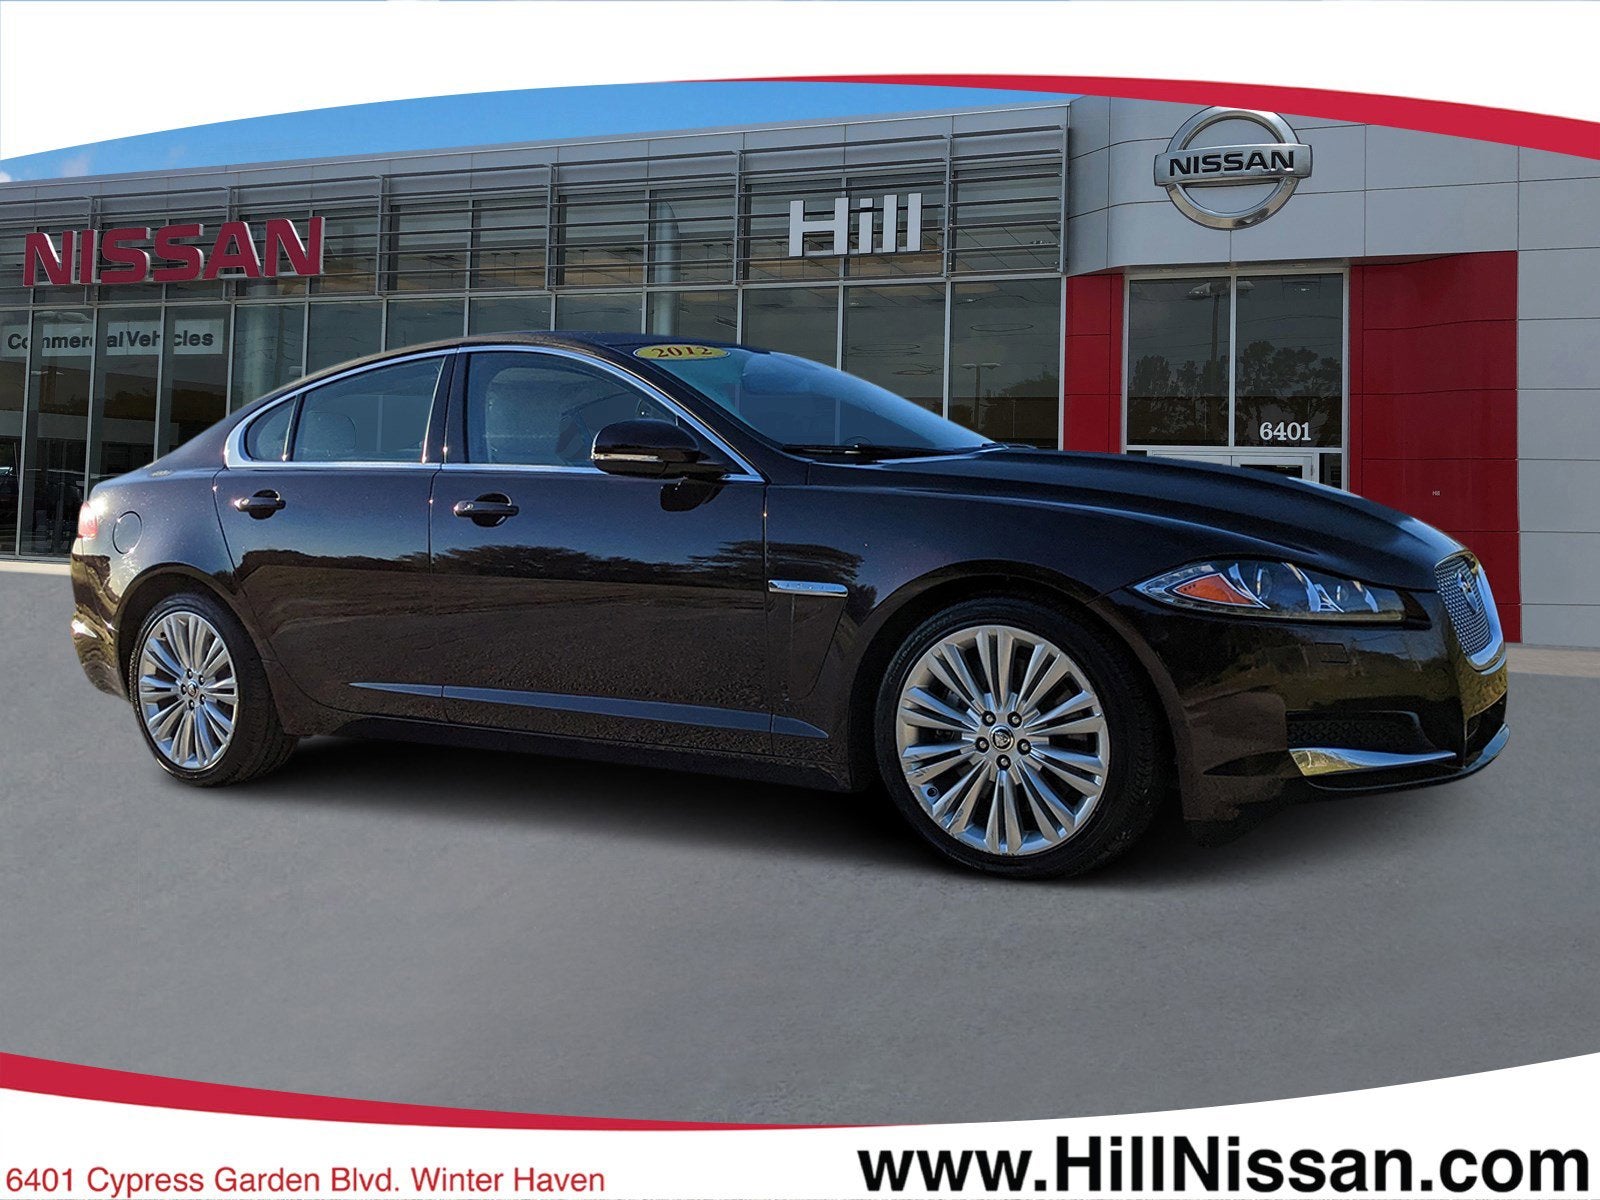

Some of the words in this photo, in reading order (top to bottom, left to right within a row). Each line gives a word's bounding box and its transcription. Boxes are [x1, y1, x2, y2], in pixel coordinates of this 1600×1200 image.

[1170, 150, 1294, 176] NISSAN
[788, 192, 923, 257] Hill
[23, 217, 325, 287] NISSAN
[8, 331, 123, 350] Comeral
[126, 330, 214, 347] Vehcles
[651, 346, 713, 358] 2012
[1259, 421, 1312, 441] 6401
